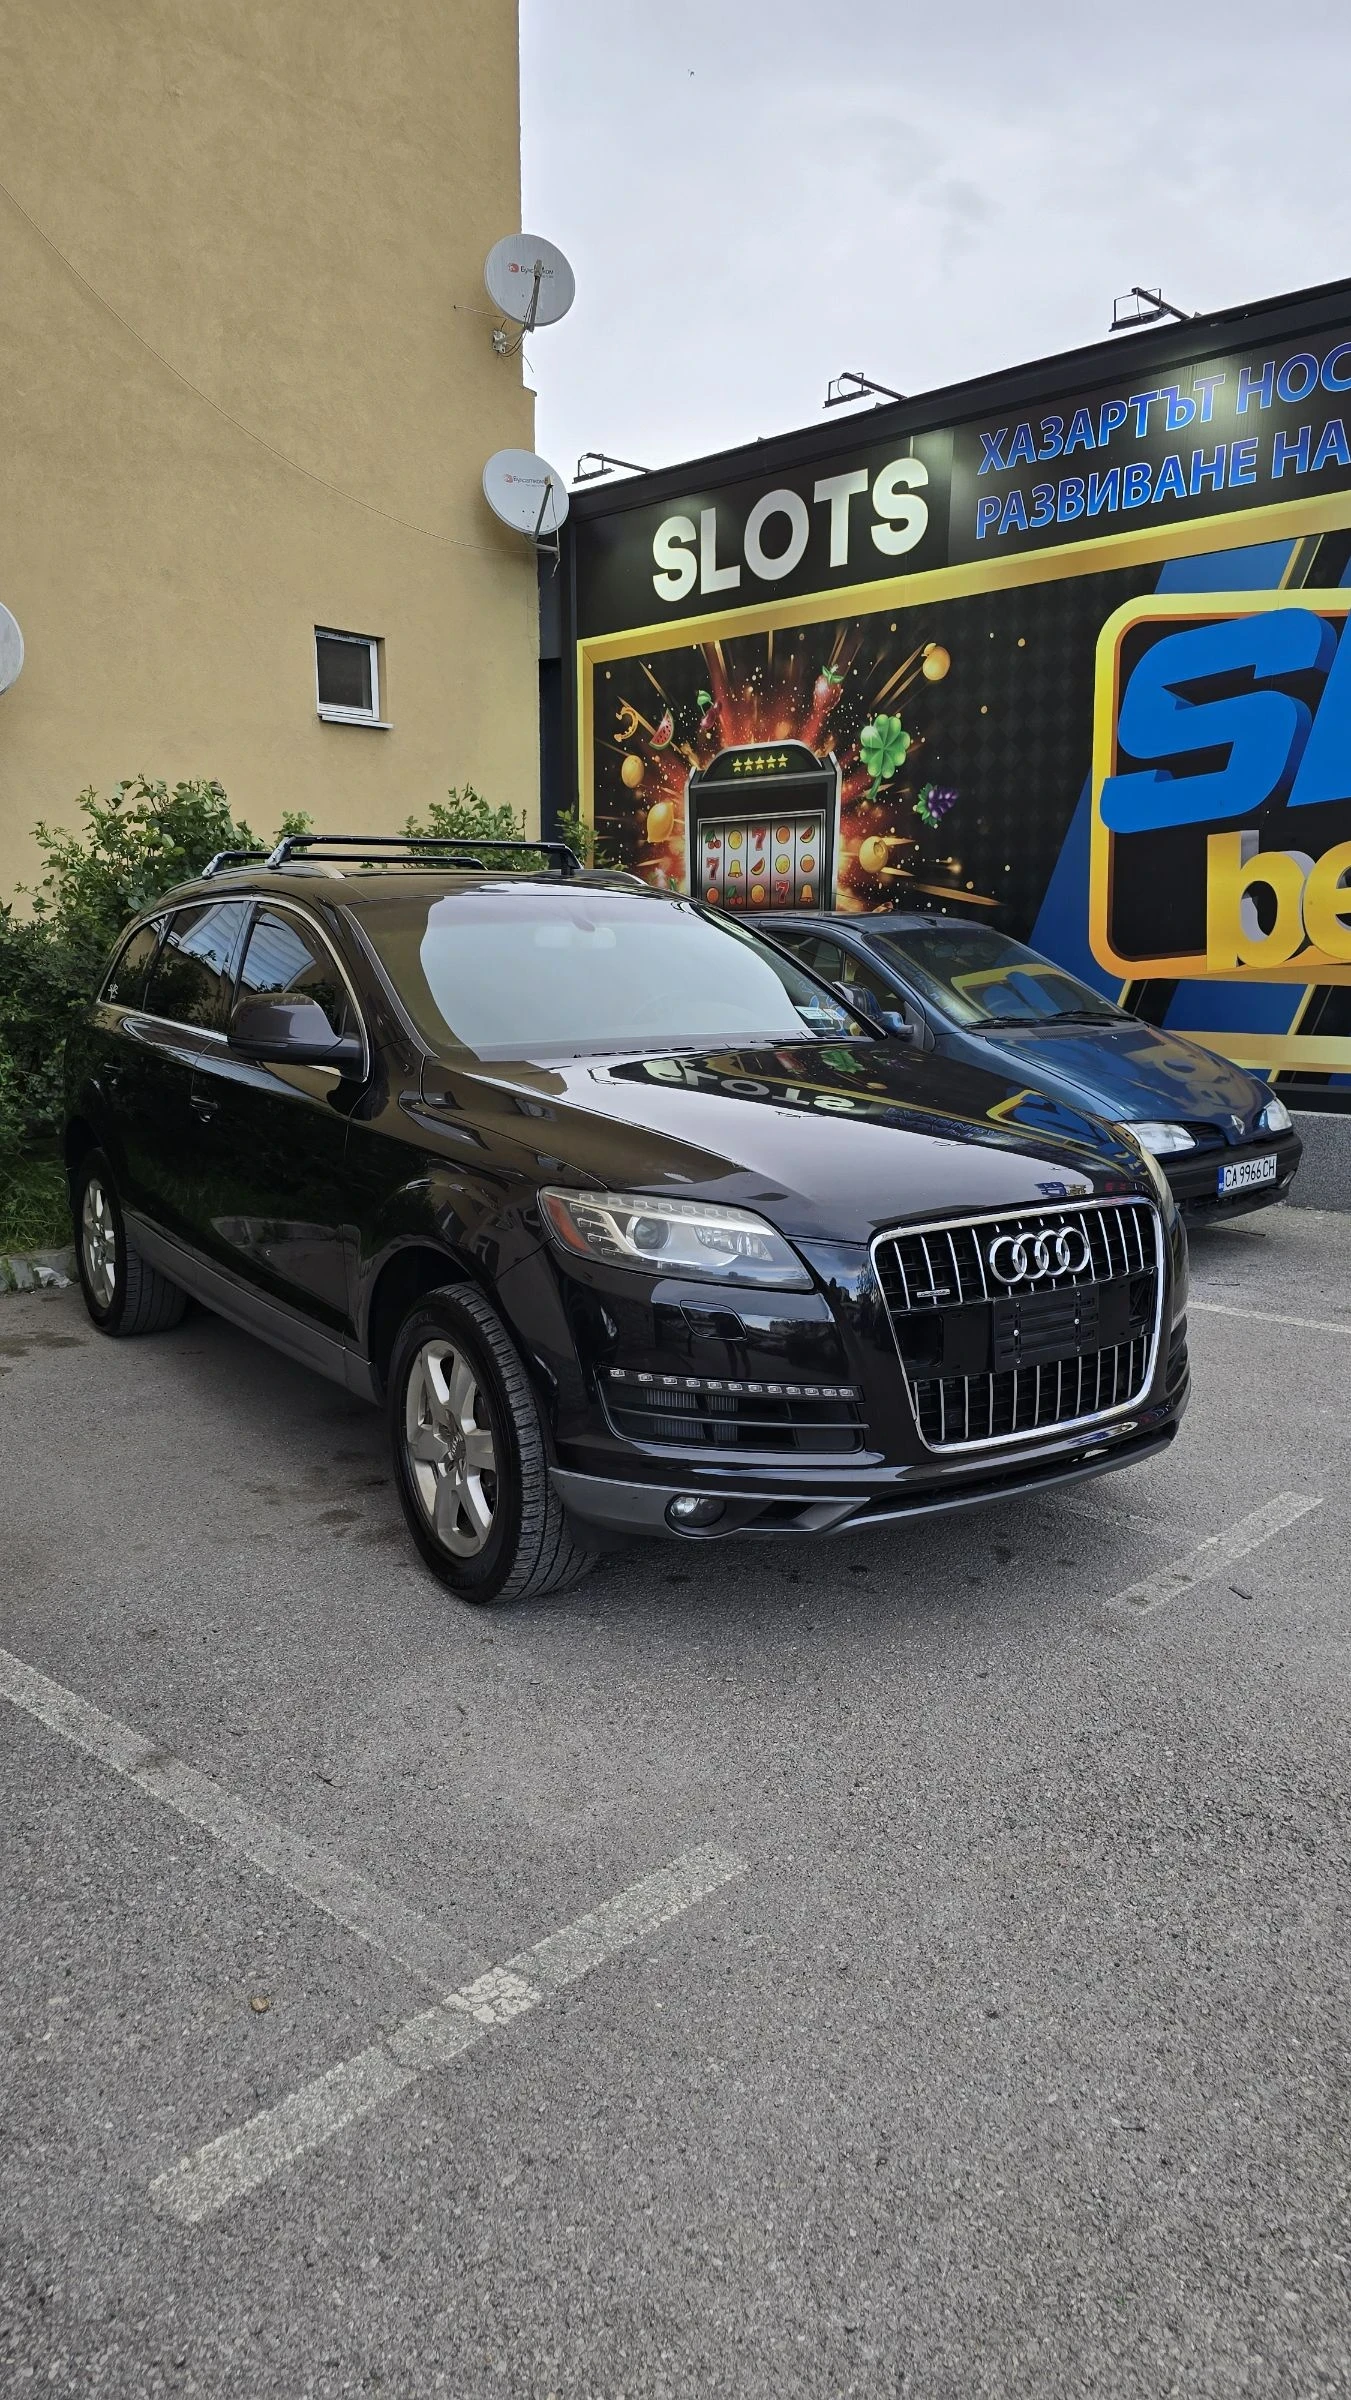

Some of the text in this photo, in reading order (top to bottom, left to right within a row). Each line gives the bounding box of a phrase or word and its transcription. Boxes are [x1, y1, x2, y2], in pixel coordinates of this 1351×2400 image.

[978, 373, 1226, 476] ХАЗАРТЪТ
[976, 418, 1351, 540] РАЗВИВАНЕ НА
[652, 457, 929, 602] SLOTS
[752, 827, 766, 851] 7
[706, 857, 720, 880] 7
[775, 880, 790, 903] 7
[1225, 1158, 1275, 1187] CA 9966 CH
